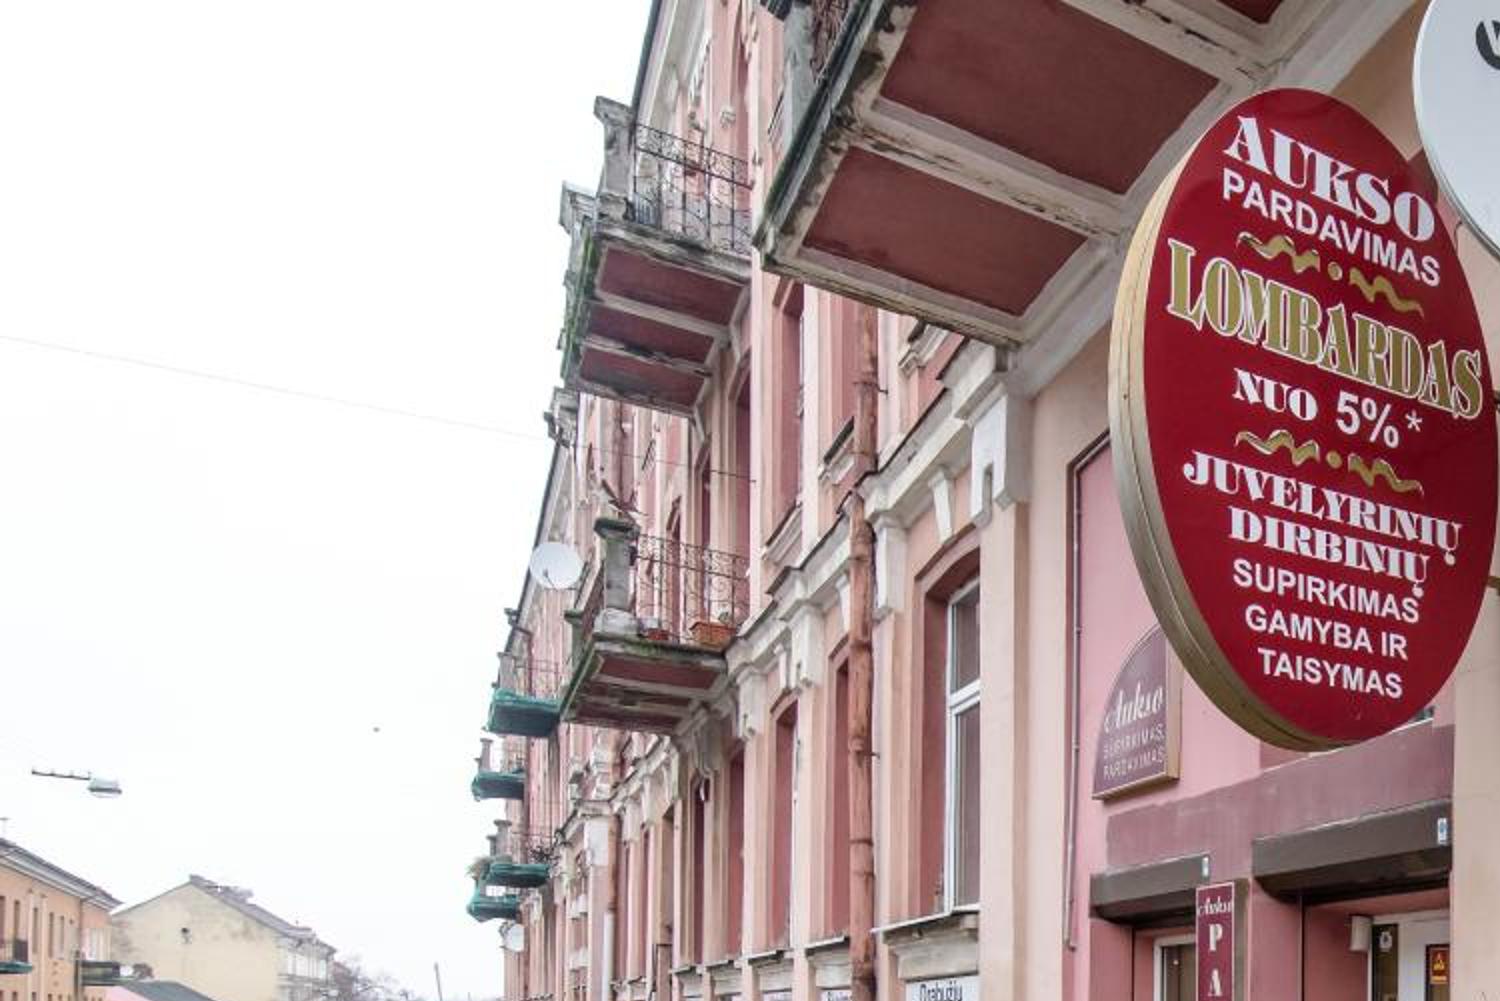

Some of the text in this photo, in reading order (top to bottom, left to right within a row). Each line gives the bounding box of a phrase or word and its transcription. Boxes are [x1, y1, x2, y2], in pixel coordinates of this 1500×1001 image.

[1222, 115, 1436, 242] AUKSO
[1222, 167, 1441, 287] PARDAVIMAS
[1166, 238, 1484, 420] LOMBARDAS
[1231, 366, 1320, 422] NUO
[1182, 450, 1463, 566] JUVELYRINIŲ
[1228, 505, 1430, 598] DIRBINIŲ
[1232, 558, 1421, 624] SUPIRKIMAS
[1244, 603, 1409, 661] GAMYBA IR
[1103, 679, 1164, 734] Aukso
[1257, 646, 1403, 700] TAISYMAS
